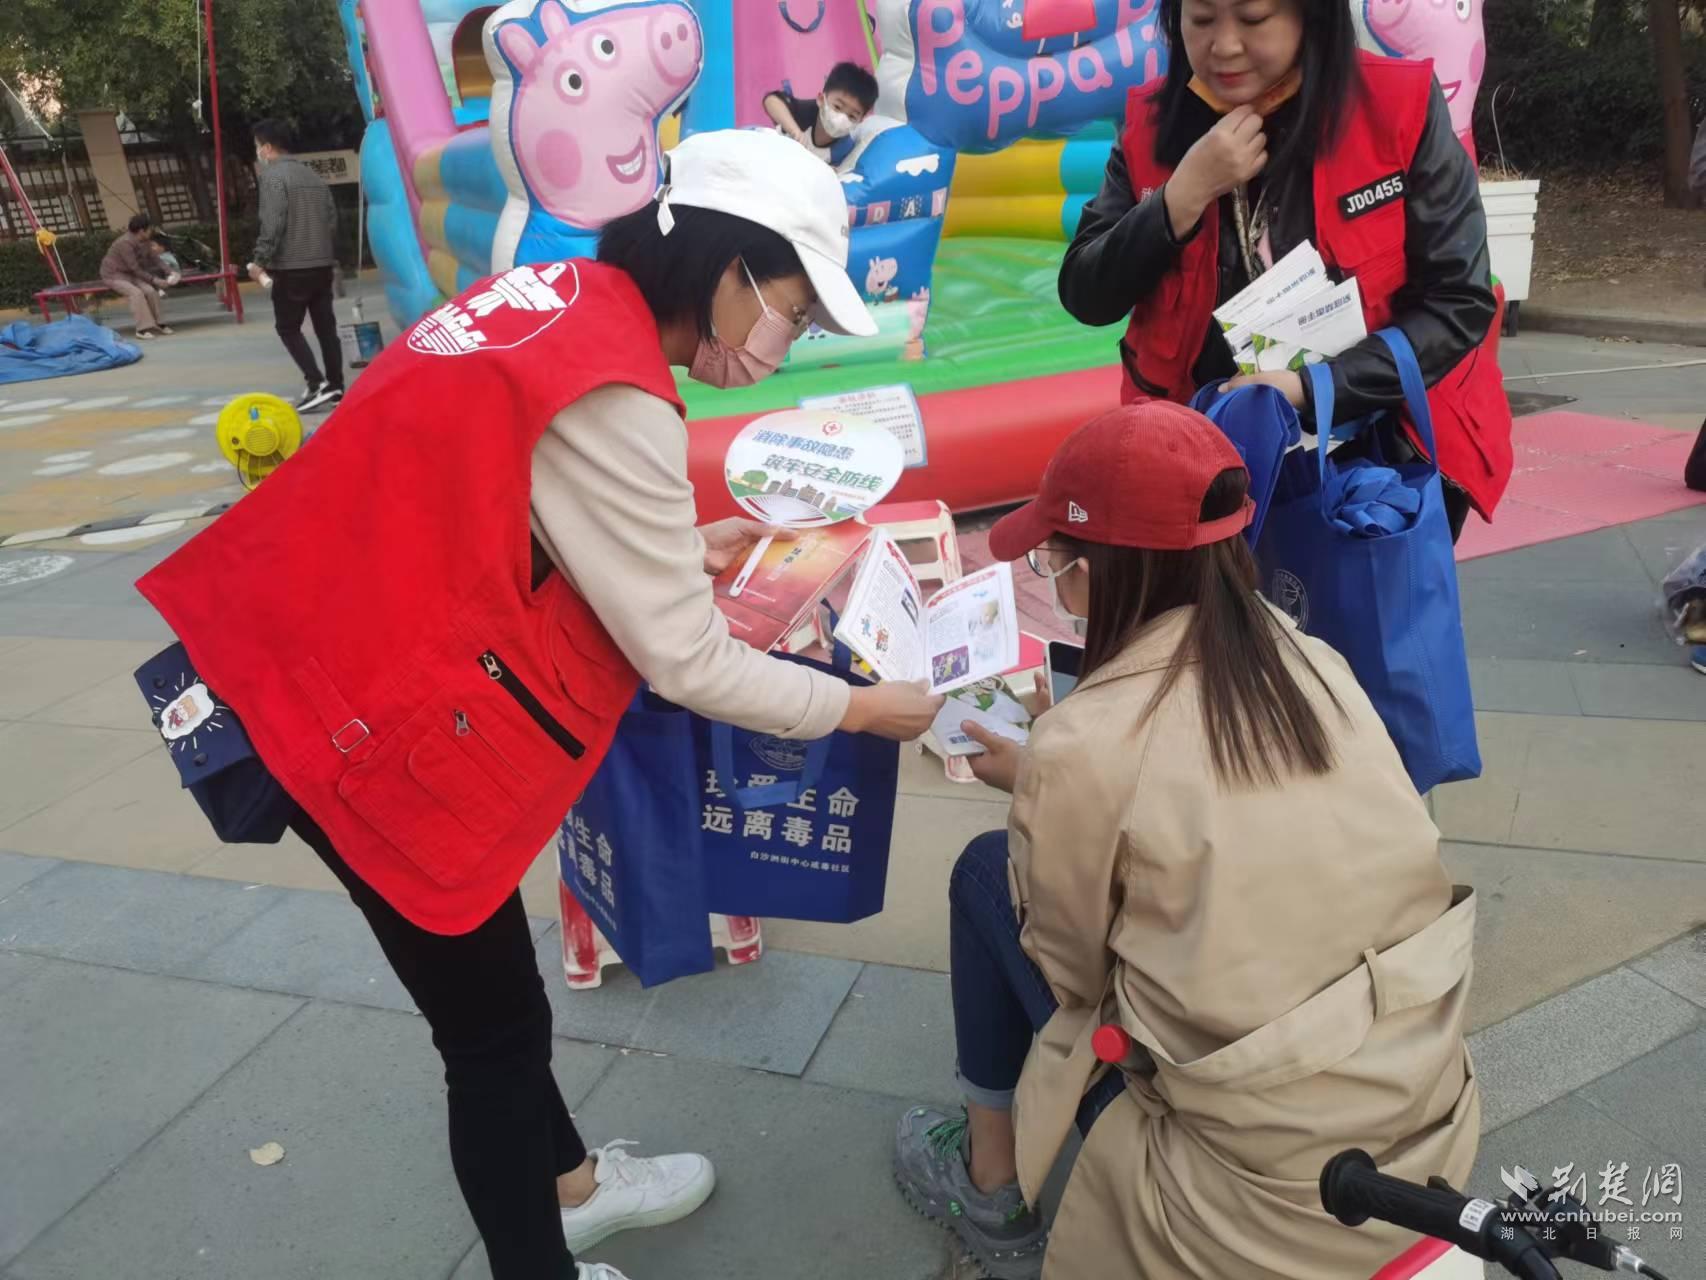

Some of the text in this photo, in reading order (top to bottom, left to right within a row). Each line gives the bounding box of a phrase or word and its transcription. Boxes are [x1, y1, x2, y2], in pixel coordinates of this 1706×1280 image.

[917, 0, 1112, 139] Peppa
[753, 428, 855, 461] 消除事故隐患
[761, 453, 883, 493] 筑牢安全防线
[701, 804, 852, 854] 远离毒品
